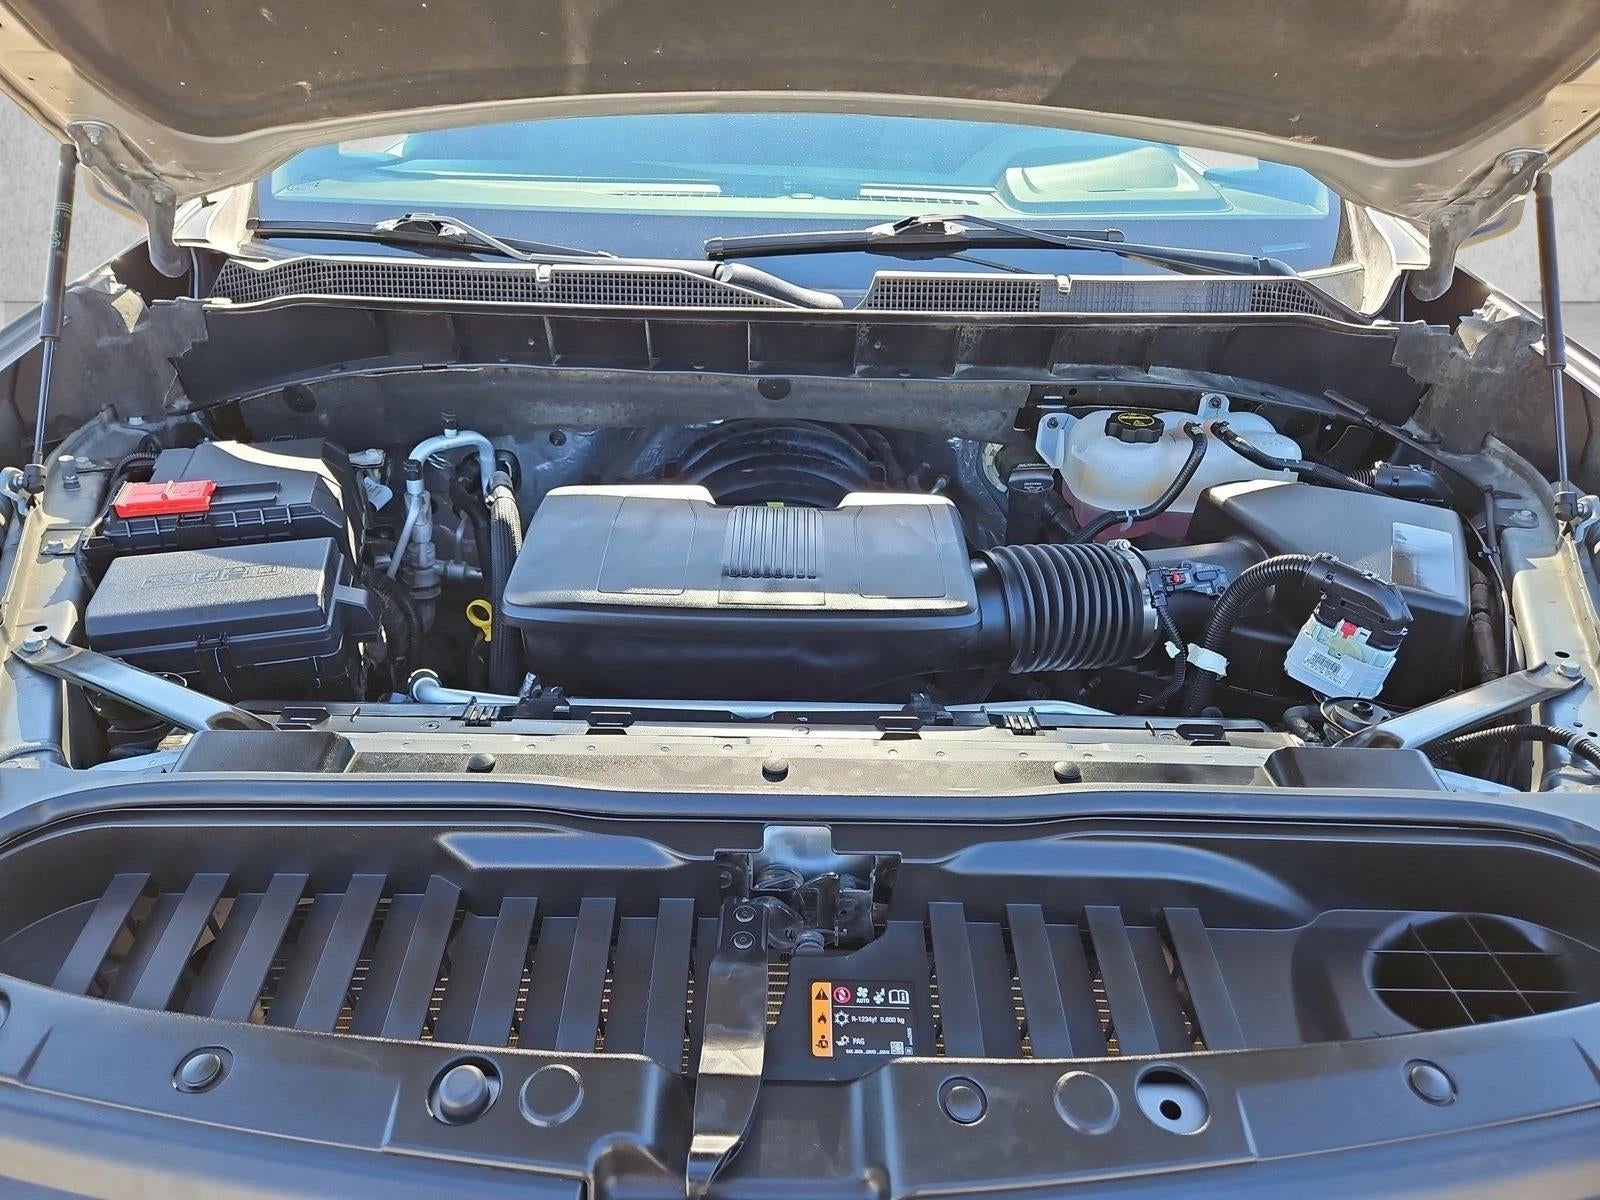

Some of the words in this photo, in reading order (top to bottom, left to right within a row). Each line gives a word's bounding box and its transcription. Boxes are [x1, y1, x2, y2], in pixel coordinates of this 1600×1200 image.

[851, 1015, 877, 1024] R-1234yf
[897, 1016, 905, 1025] kg
[852, 1037, 865, 1045] PAG
